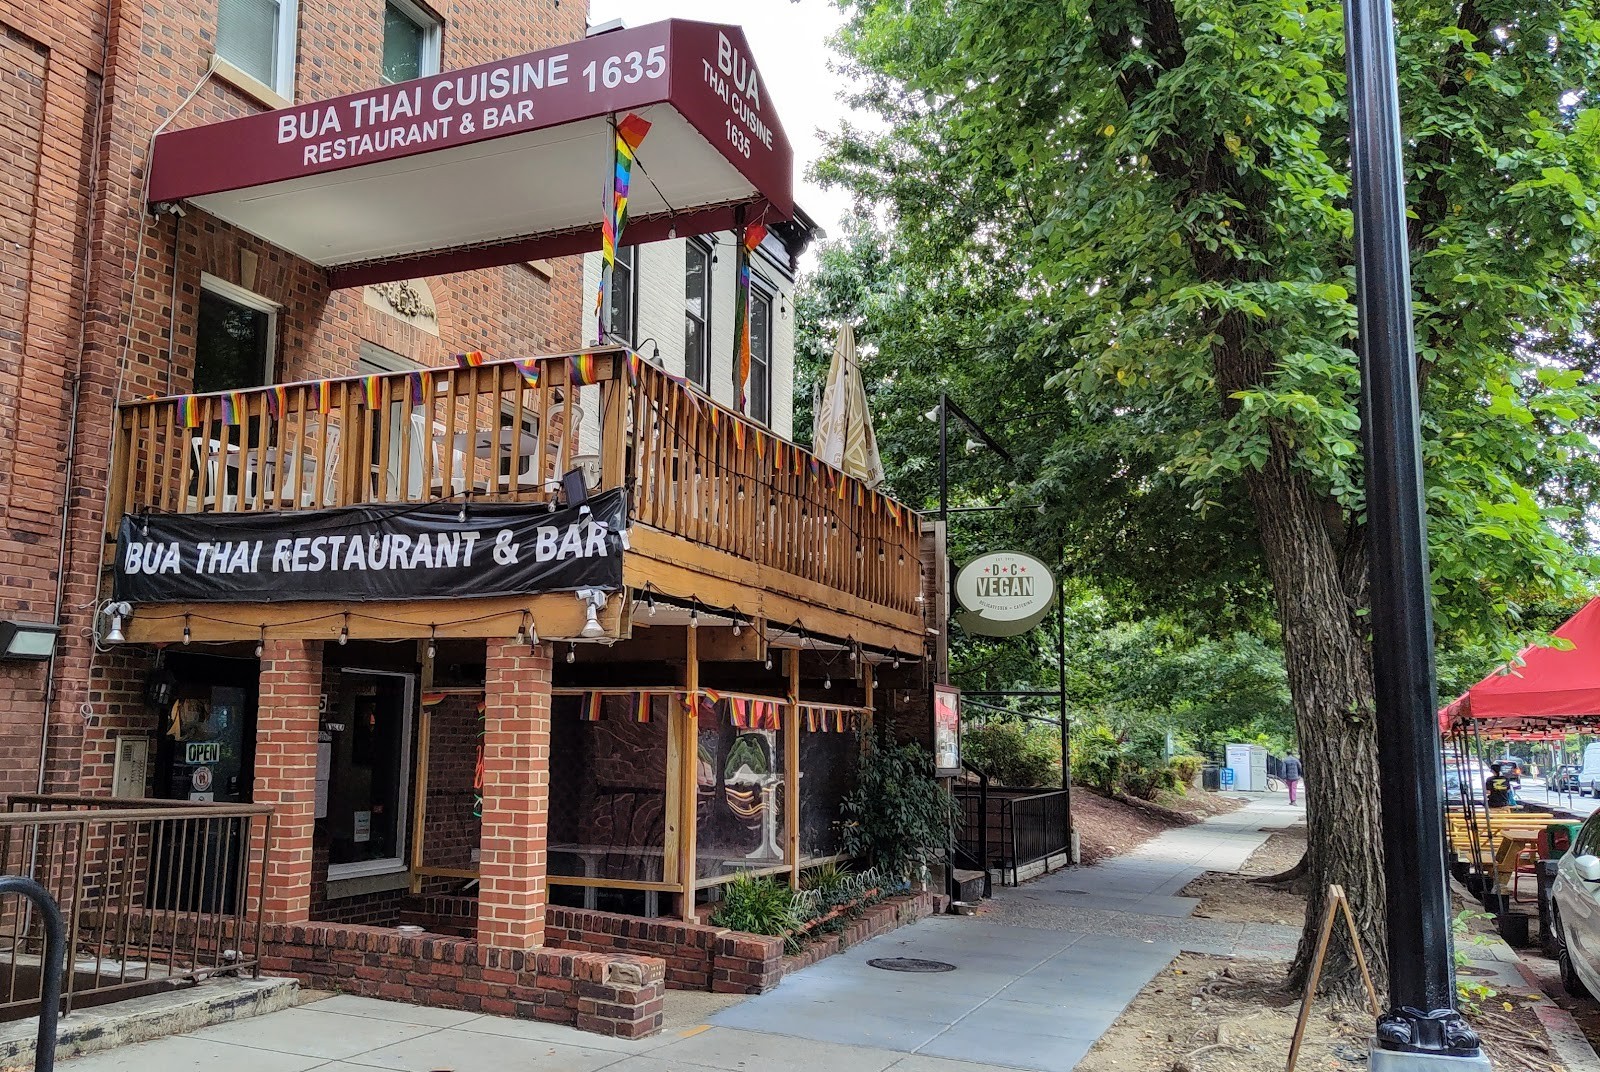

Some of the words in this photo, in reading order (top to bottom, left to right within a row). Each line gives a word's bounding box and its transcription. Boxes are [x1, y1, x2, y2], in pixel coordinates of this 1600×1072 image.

[278, 106, 341, 144] BUA
[350, 87, 422, 128] THAI
[432, 53, 569, 111] CUISINE
[582, 44, 666, 93] 1635
[718, 30, 760, 111] BUA
[303, 116, 452, 166] RESTAURANT
[459, 112, 476, 135] &
[482, 99, 534, 130] BAR
[702, 57, 729, 105] THAI
[731, 92, 773, 151] CUISINE
[725, 118, 751, 159] 1635
[124, 541, 181, 575] BUA
[195, 540, 263, 574] THAI
[272, 531, 481, 573] RESTAURANT
[493, 529, 520, 566] &
[536, 521, 609, 563] BAR
[977, 576, 1034, 597] VEGAN
[188, 744, 218, 762] OPEN
